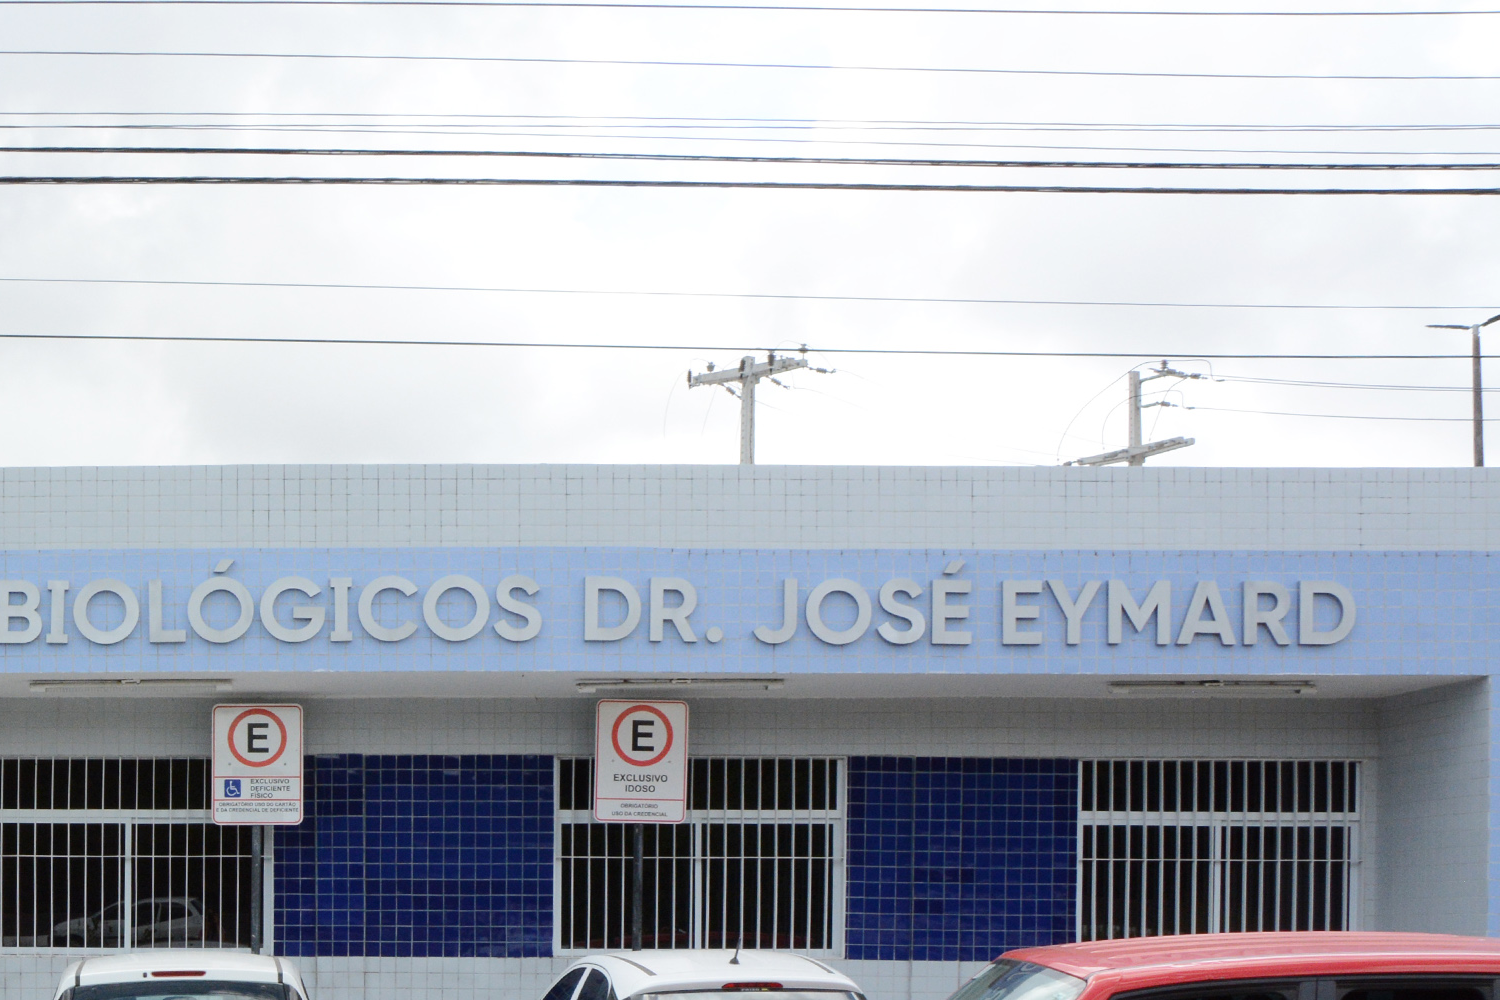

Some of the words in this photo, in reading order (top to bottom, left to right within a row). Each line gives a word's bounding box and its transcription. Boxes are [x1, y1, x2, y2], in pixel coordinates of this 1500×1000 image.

[584, 576, 723, 643] DR.
[753, 559, 972, 646] JOSÉ
[1001, 579, 1357, 646] EYMARD
[247, 723, 269, 753] E
[632, 720, 654, 751] E
[613, 774, 668, 782] EXCLUSIVO
